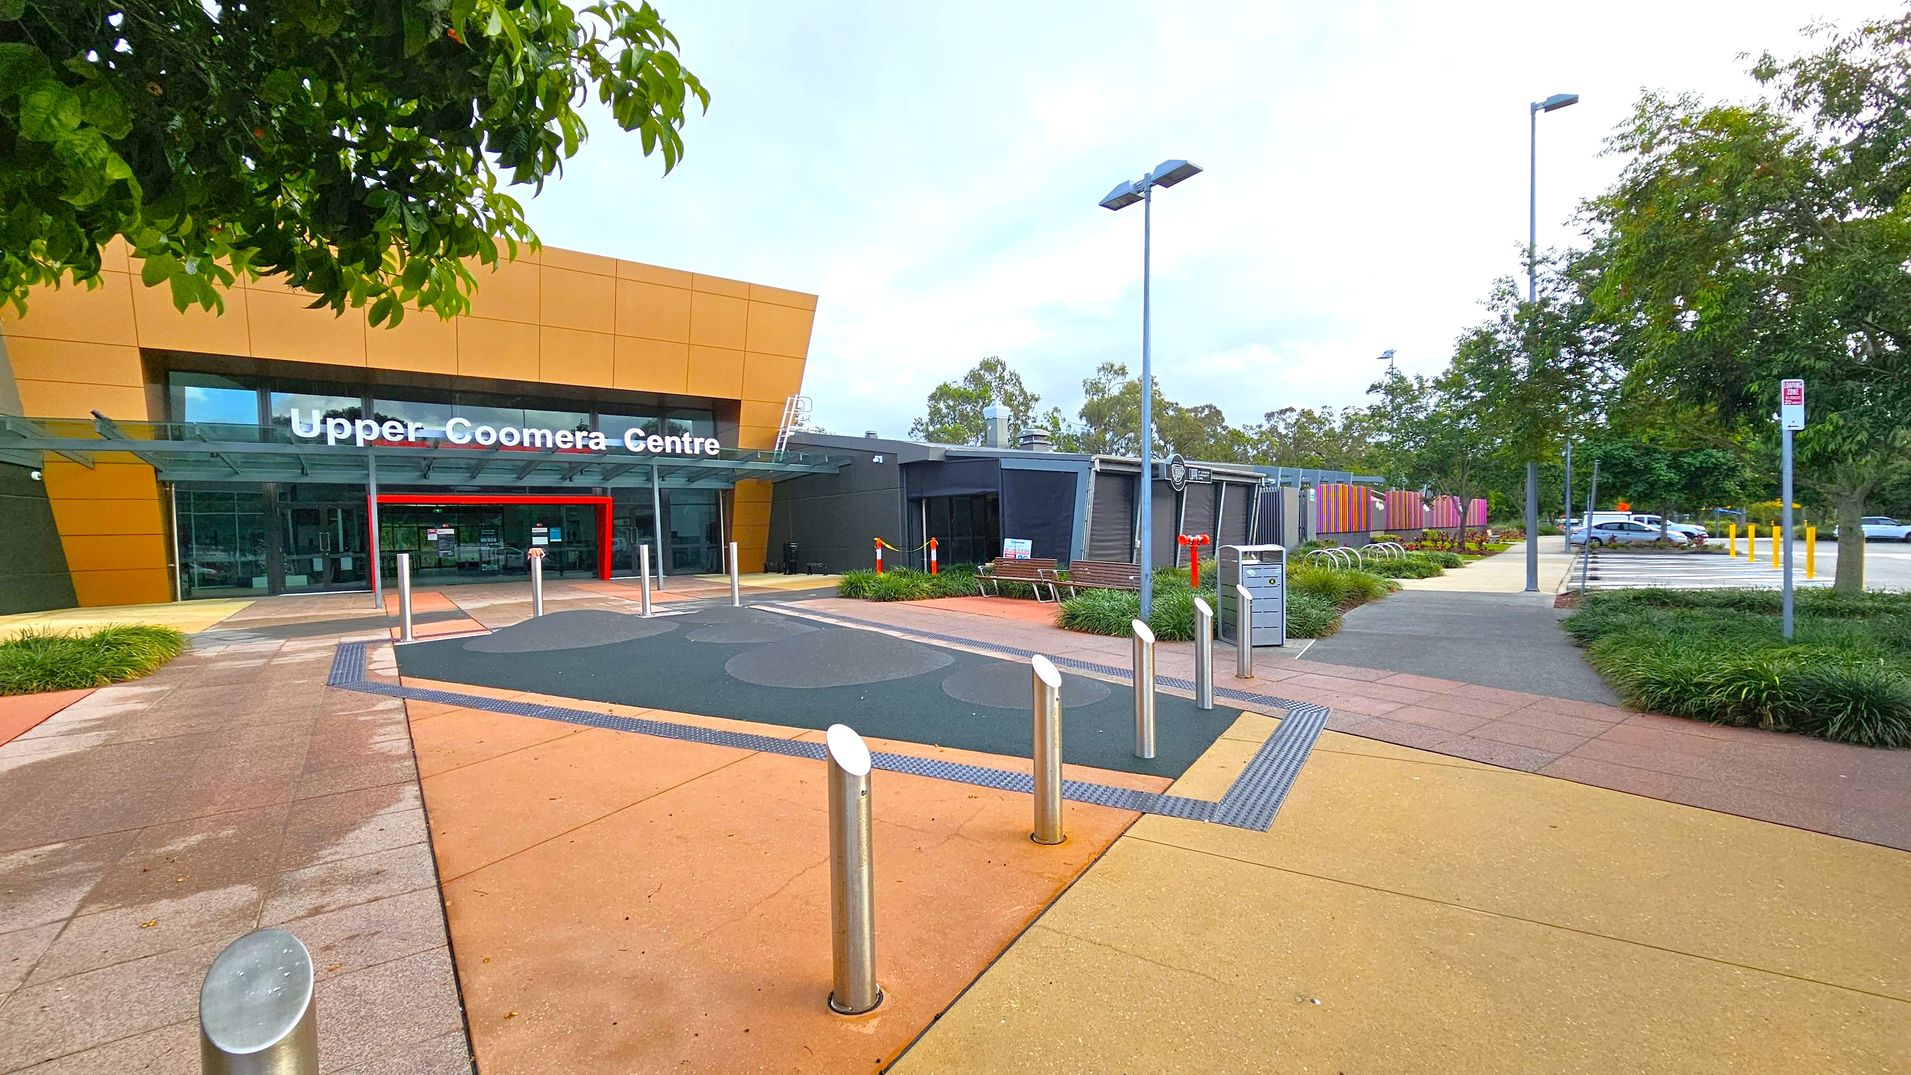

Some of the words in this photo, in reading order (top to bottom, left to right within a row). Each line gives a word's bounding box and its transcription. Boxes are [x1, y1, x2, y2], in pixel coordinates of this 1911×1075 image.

[290, 408, 424, 447] Upper
[445, 417, 607, 451] Coomera
[624, 427, 721, 456] Centre
